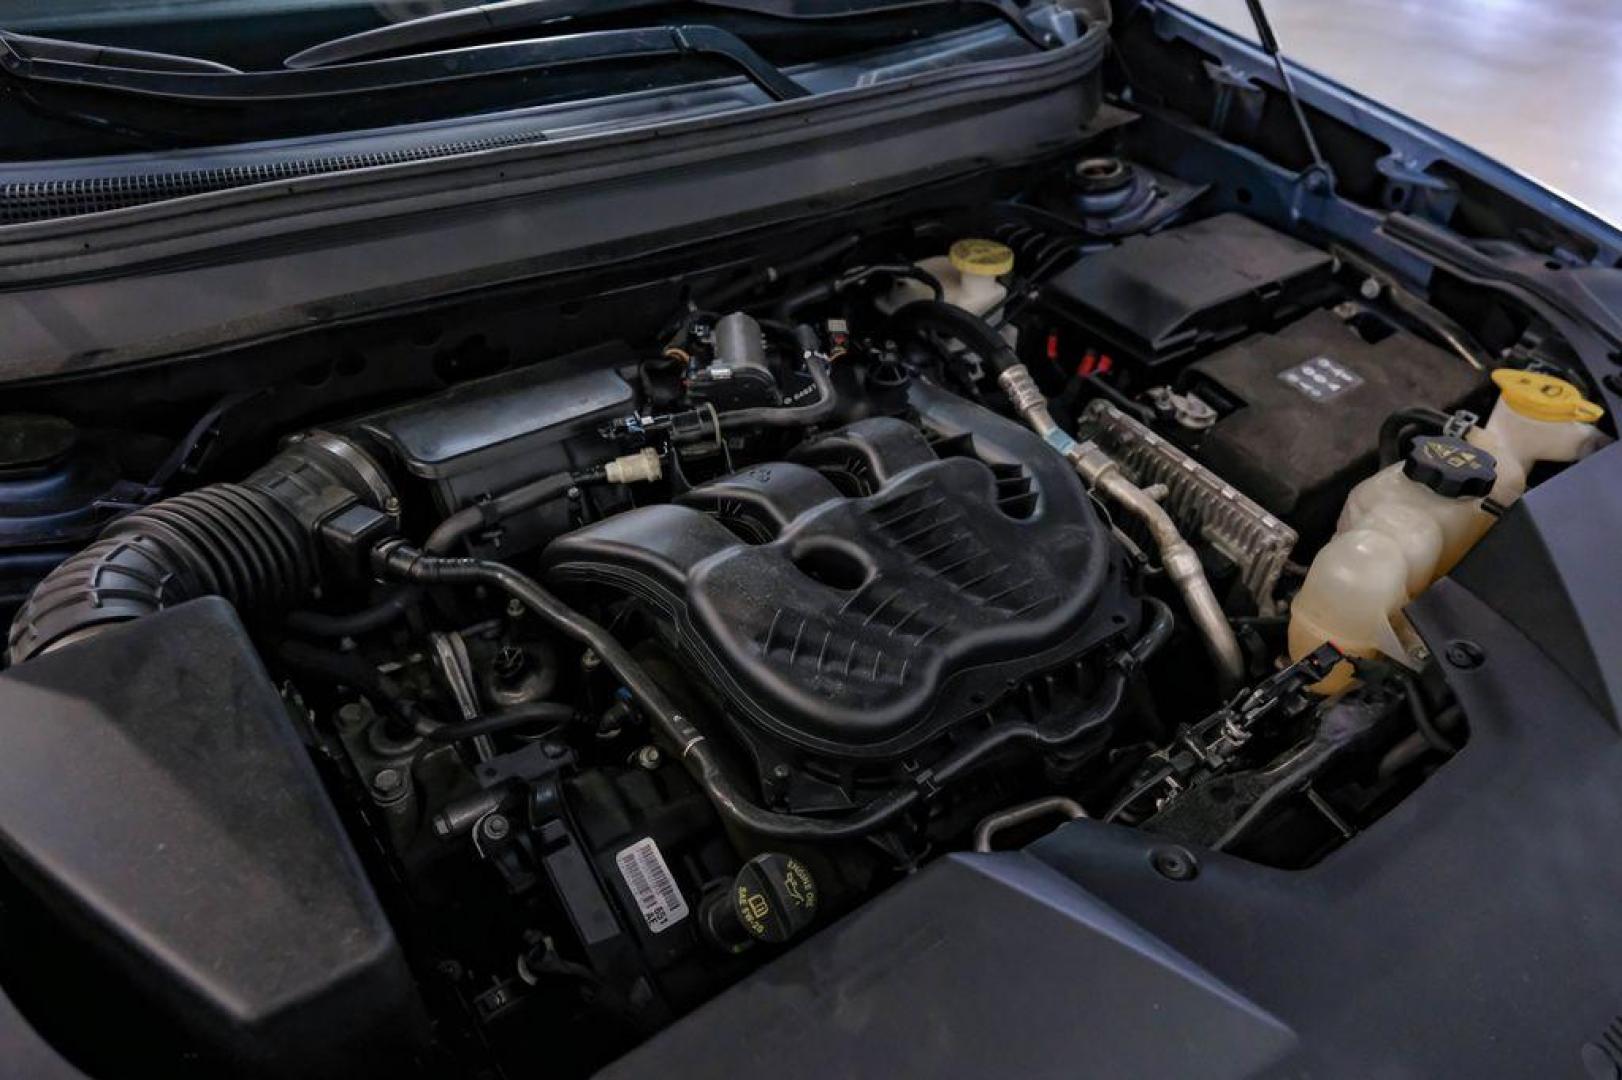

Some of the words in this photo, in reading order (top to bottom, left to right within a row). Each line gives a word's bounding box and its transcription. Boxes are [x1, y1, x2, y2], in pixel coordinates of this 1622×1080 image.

[739, 886, 748, 907] SAE
[786, 858, 812, 890] ENGINE
[805, 892, 815, 908] OIL
